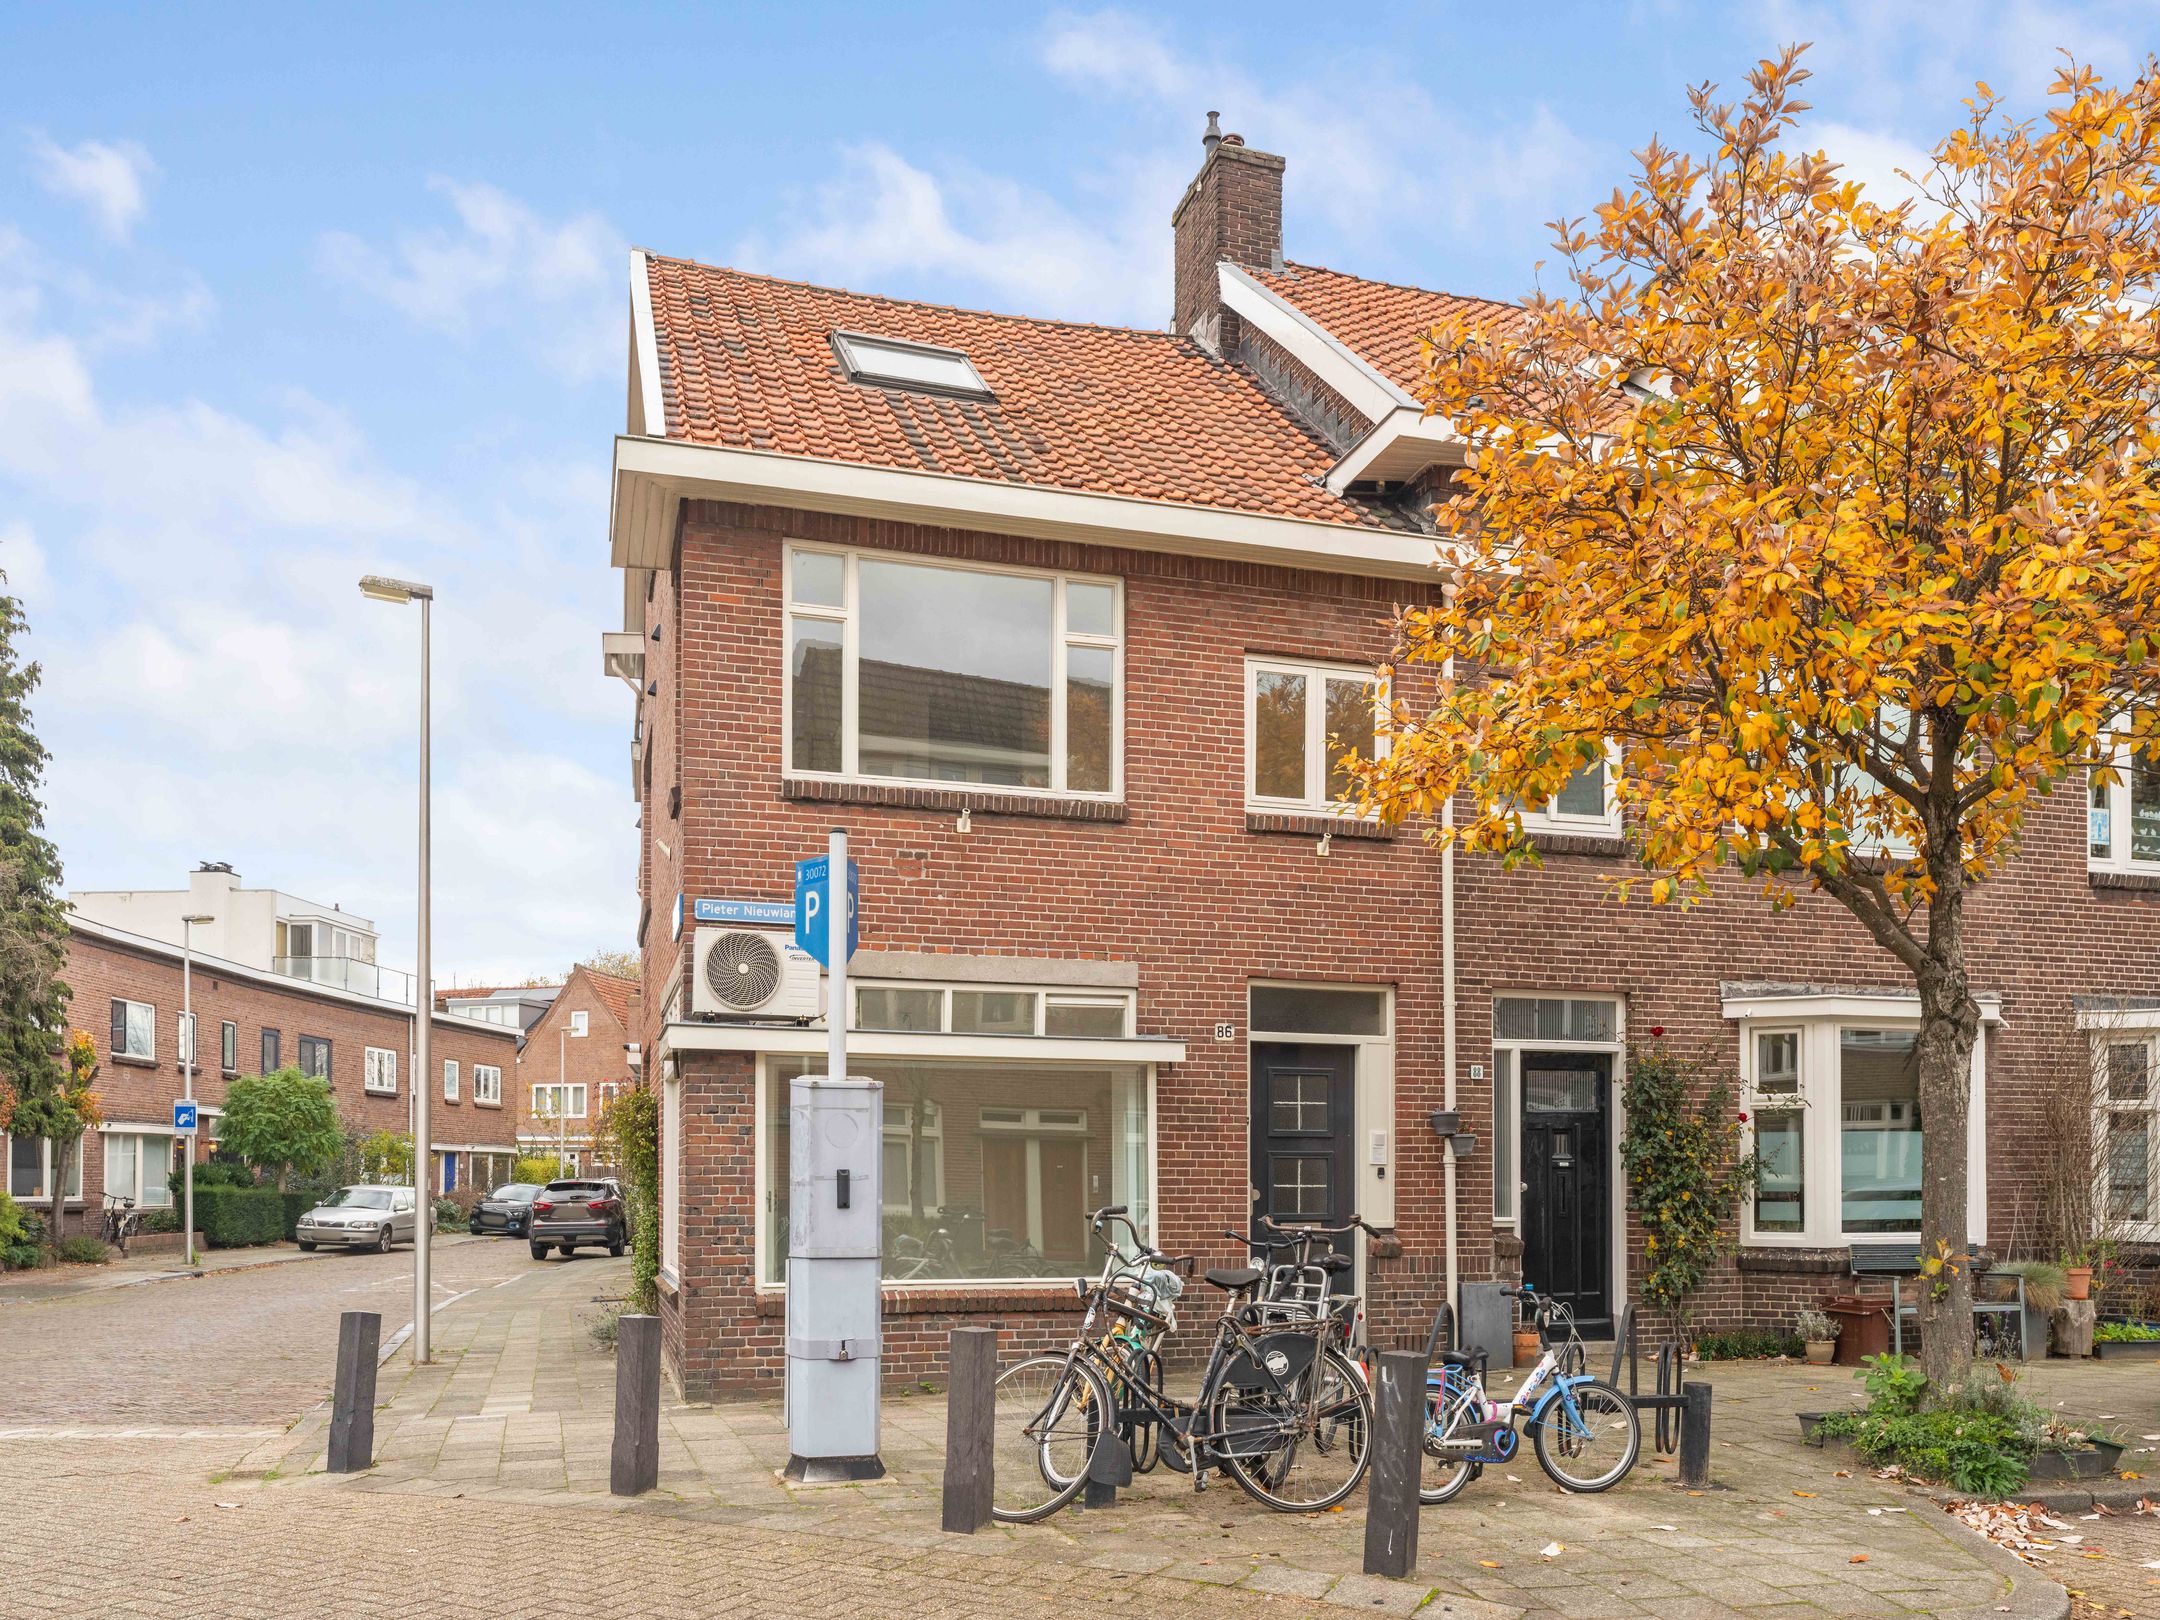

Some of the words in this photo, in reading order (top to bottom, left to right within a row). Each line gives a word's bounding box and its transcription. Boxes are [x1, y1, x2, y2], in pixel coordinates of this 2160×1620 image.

[805, 865, 827, 880] 30072
[702, 903, 739, 915] Pieter
[805, 891, 820, 934] P
[847, 892, 855, 933] P
[1217, 1026, 1232, 1038] 86
[1472, 1067, 1481, 1077] 88
